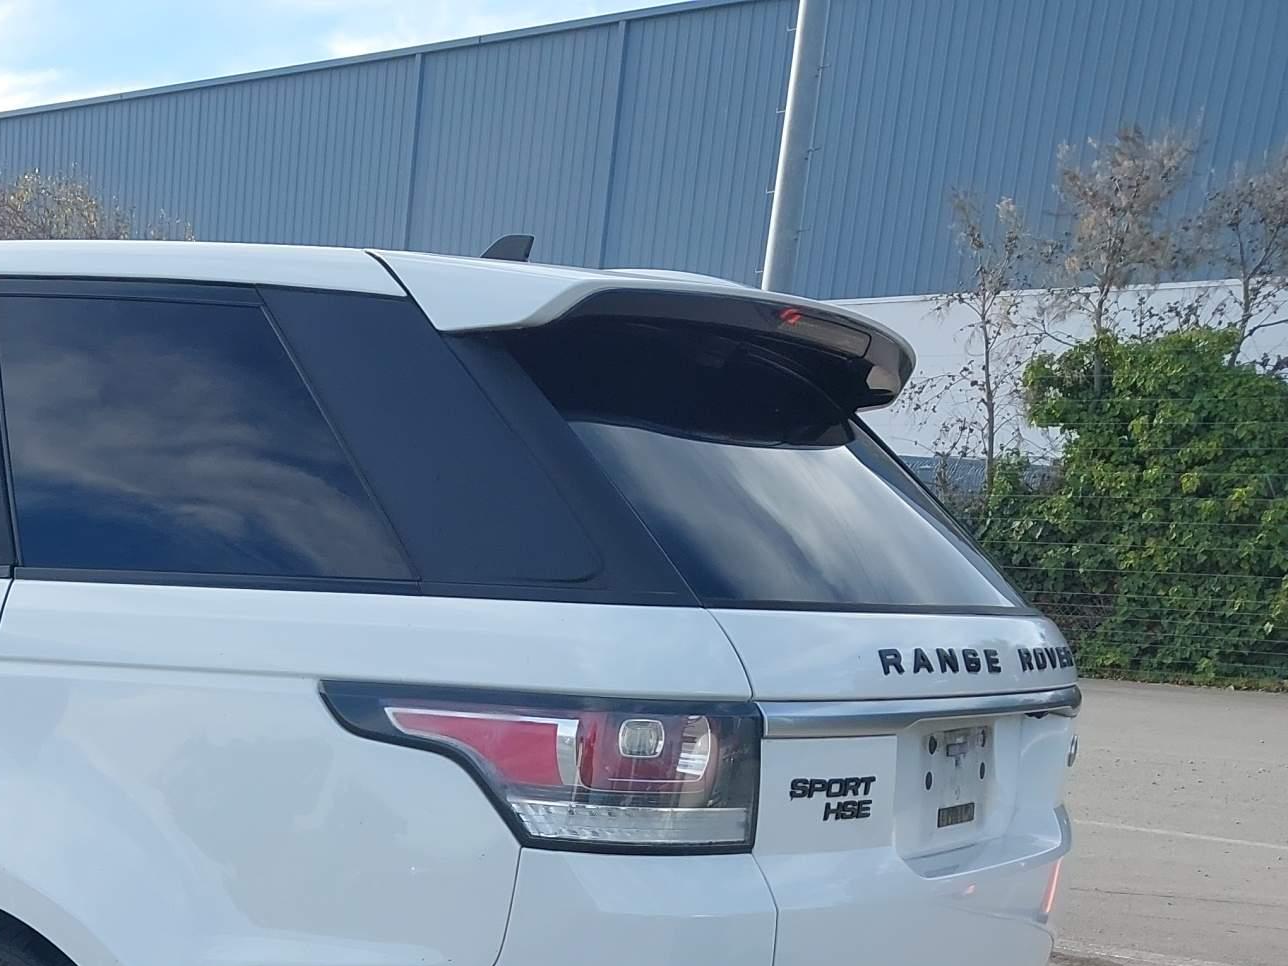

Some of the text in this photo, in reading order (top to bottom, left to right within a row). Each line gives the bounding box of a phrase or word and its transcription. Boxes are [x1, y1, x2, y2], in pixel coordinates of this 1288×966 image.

[878, 648, 1002, 676] RANGE
[789, 776, 876, 800] SPORT
[822, 799, 873, 821] HSE
